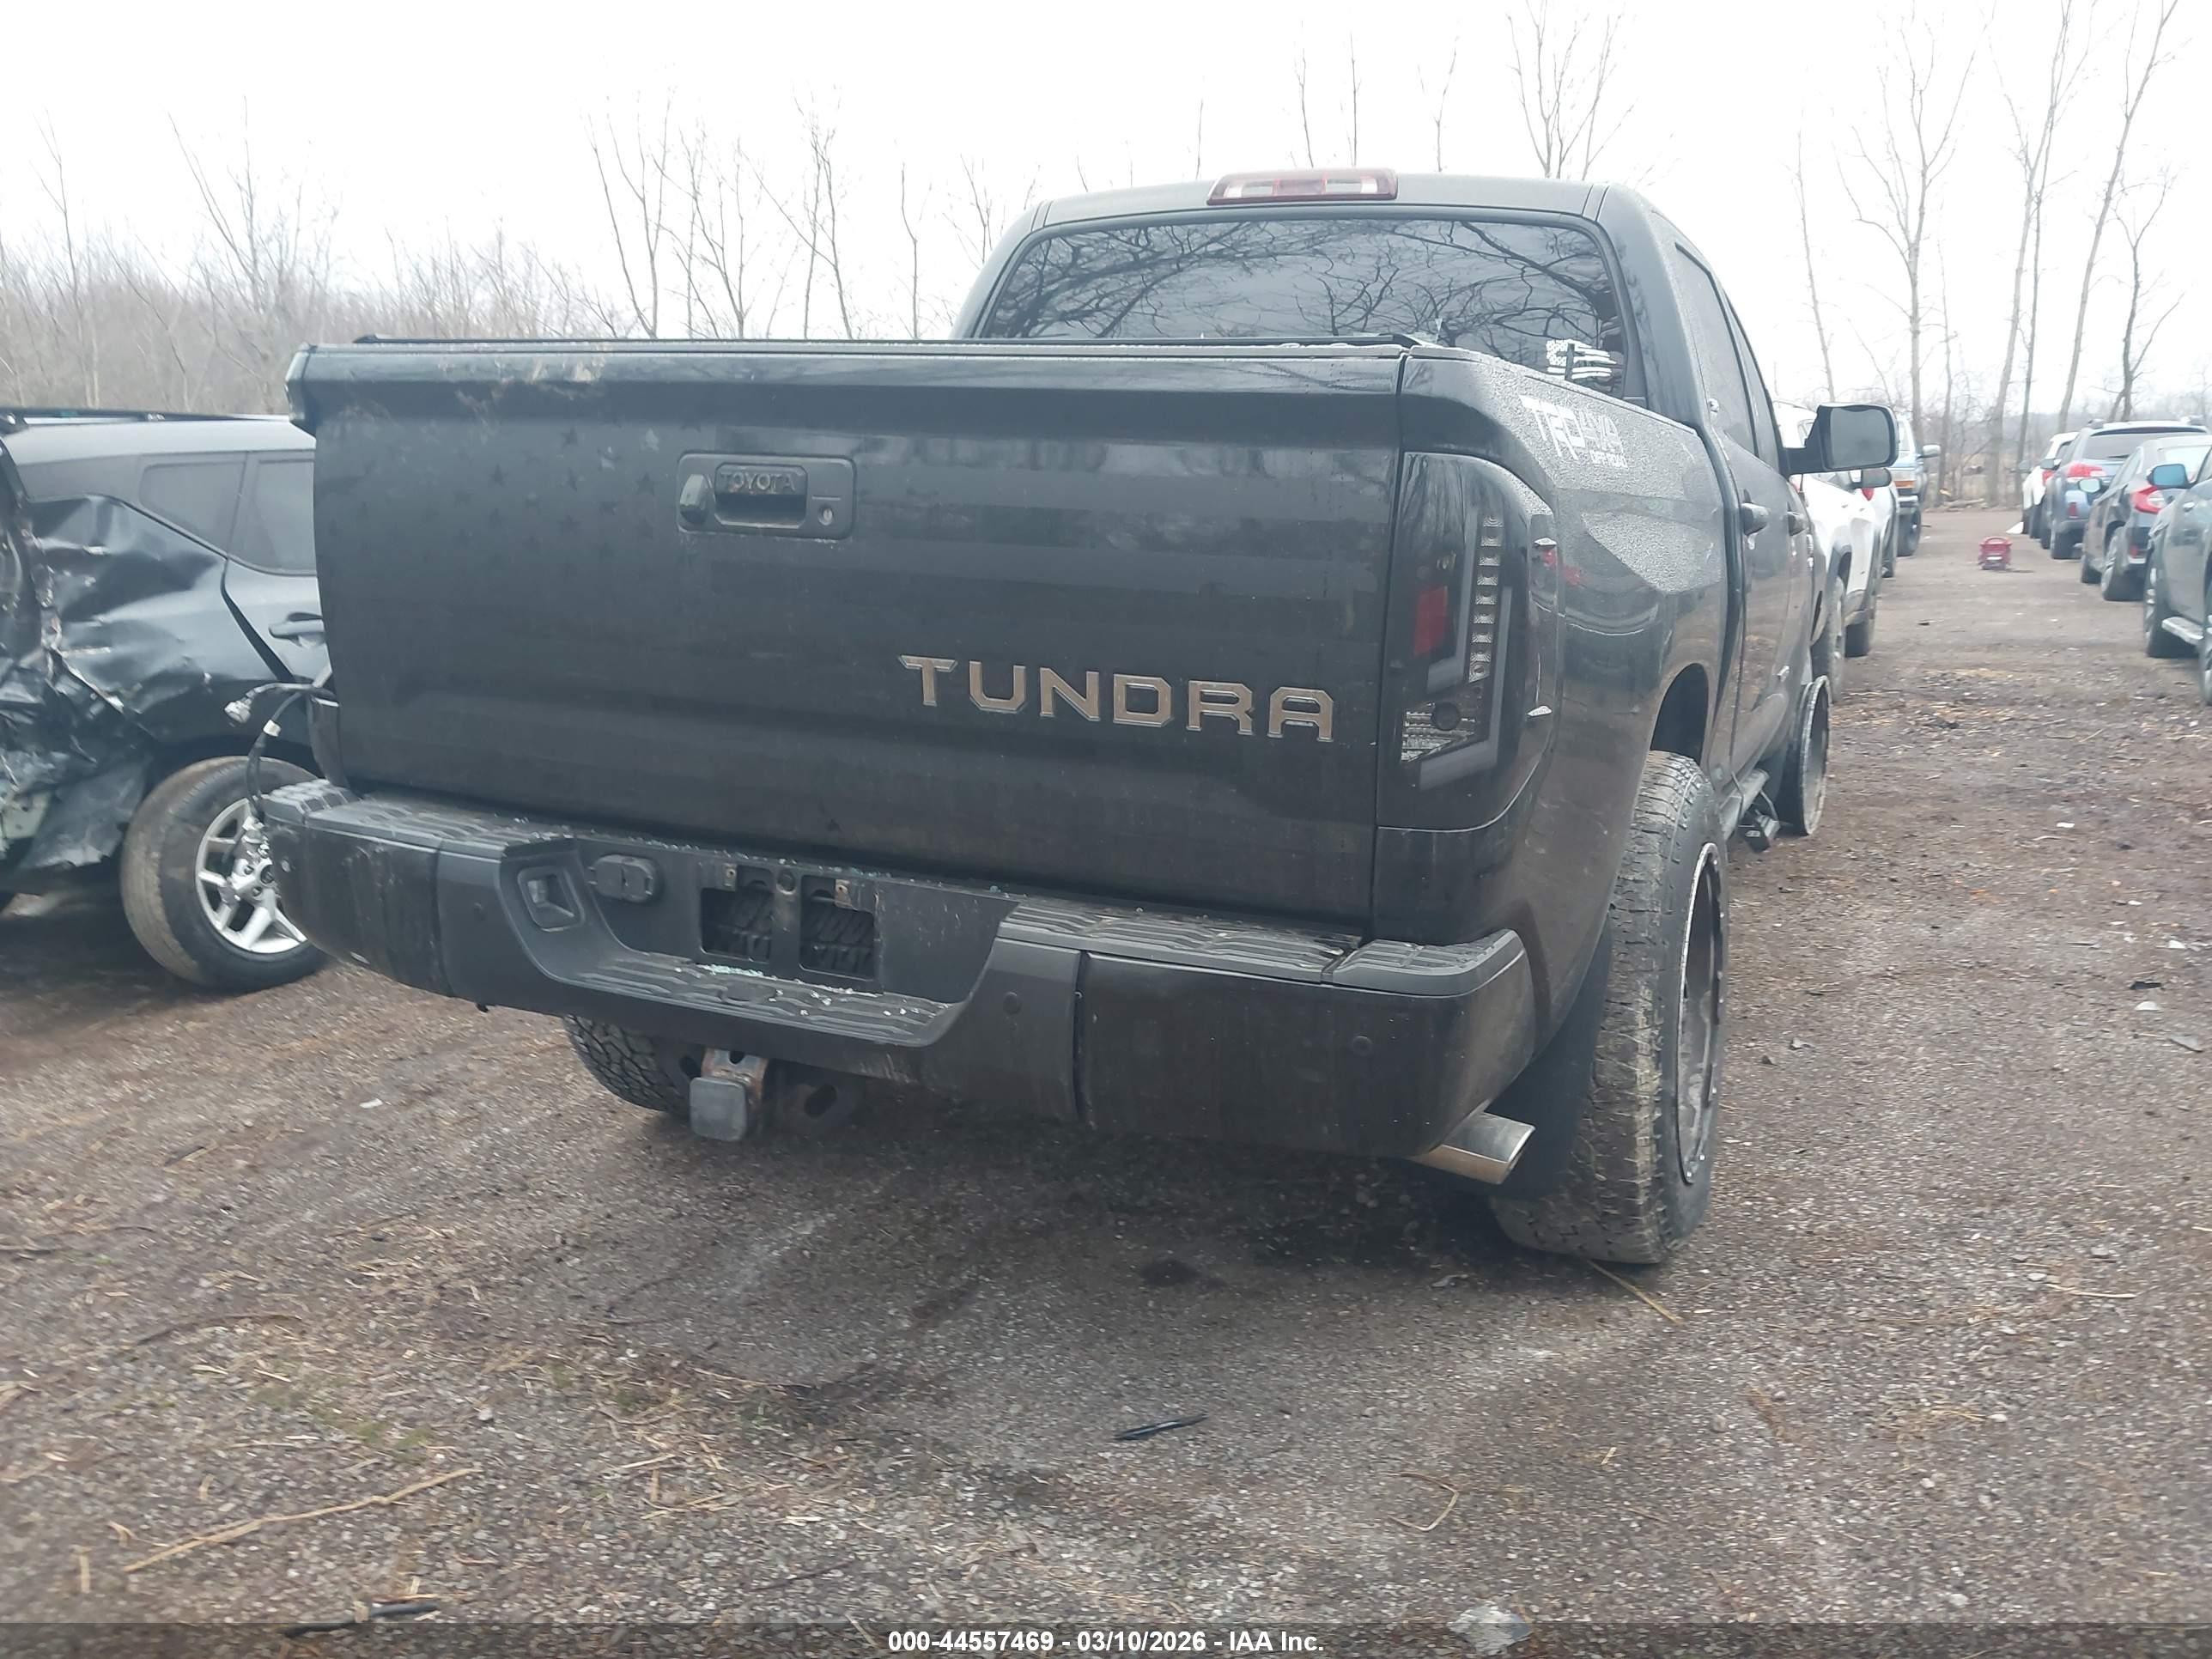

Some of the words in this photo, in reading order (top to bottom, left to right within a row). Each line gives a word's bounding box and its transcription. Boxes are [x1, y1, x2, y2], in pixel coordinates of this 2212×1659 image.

[1518, 394, 1585, 460] TRD
[720, 471, 796, 495] TOYOTA
[898, 653, 1334, 743] TUNDRA
